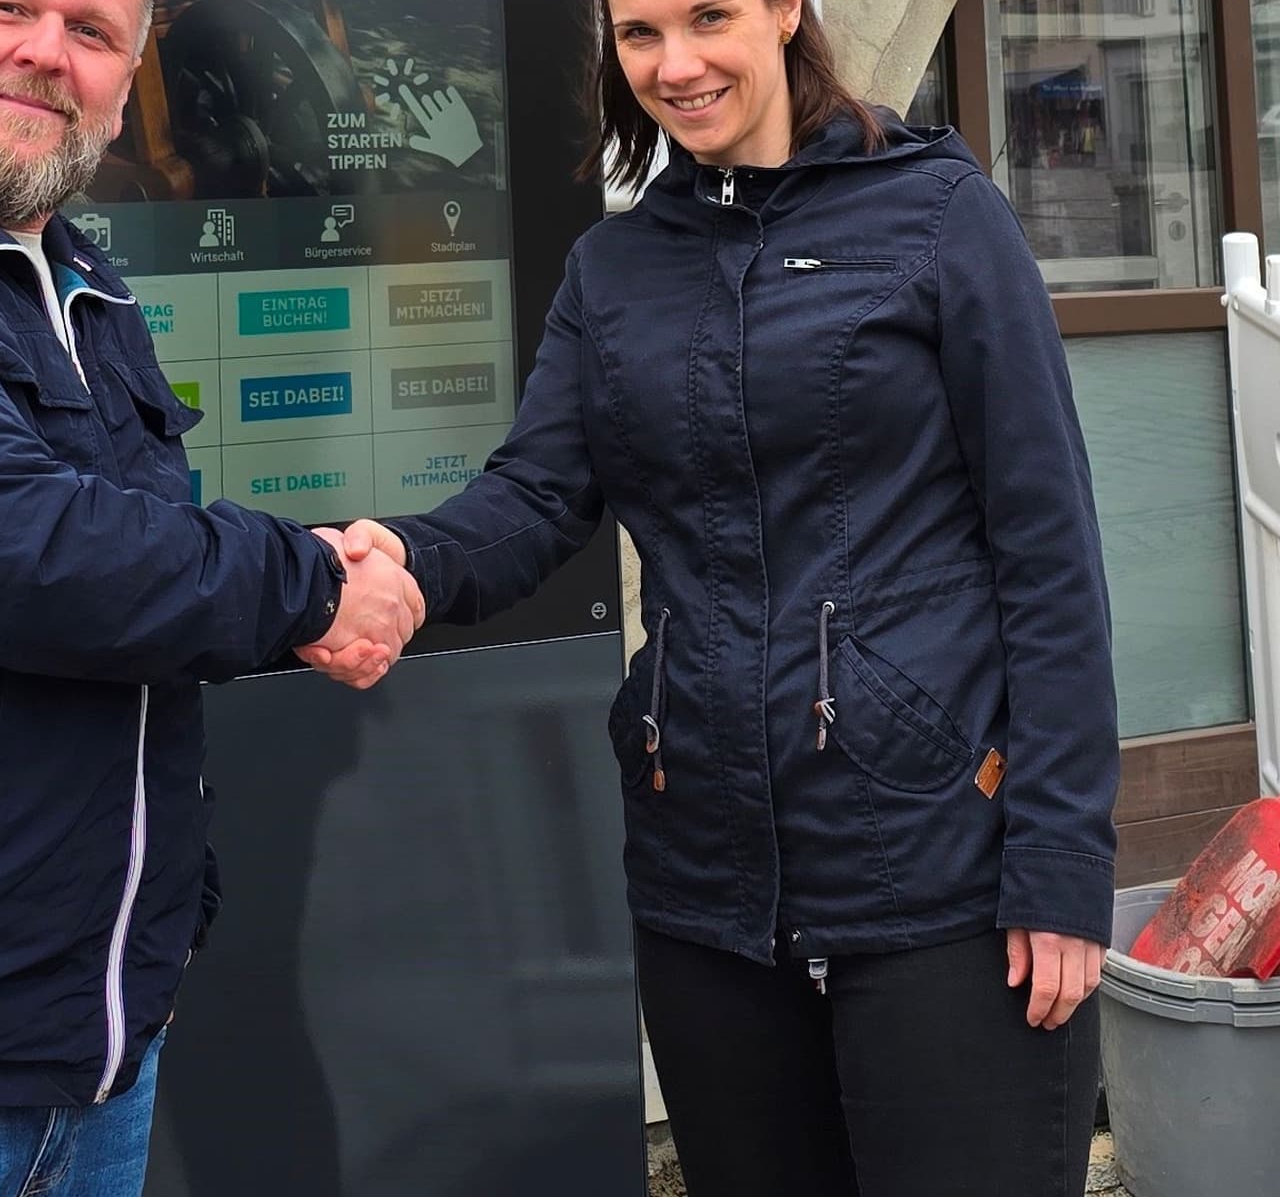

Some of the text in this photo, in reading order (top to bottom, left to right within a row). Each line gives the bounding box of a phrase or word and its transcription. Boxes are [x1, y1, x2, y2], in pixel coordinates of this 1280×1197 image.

[327, 112, 366, 129] ZUM
[327, 132, 402, 151] STARTEN
[328, 153, 388, 172] TIPPEN
[304, 245, 372, 260] Bürgerservice
[431, 241, 476, 254] Stadtplan
[190, 250, 245, 264] Wirtschaft
[261, 296, 327, 312] EINTRAG
[420, 289, 462, 304] JETZT
[263, 310, 328, 327] BUCHEN!
[396, 301, 486, 320] MITMACHEN!
[398, 374, 489, 396] SEI DABEI!
[248, 386, 345, 408] SEI DABEI!
[425, 454, 467, 470] JETZT
[251, 472, 347, 494] SEI DABEI!
[401, 467, 485, 489] MITMACHE
